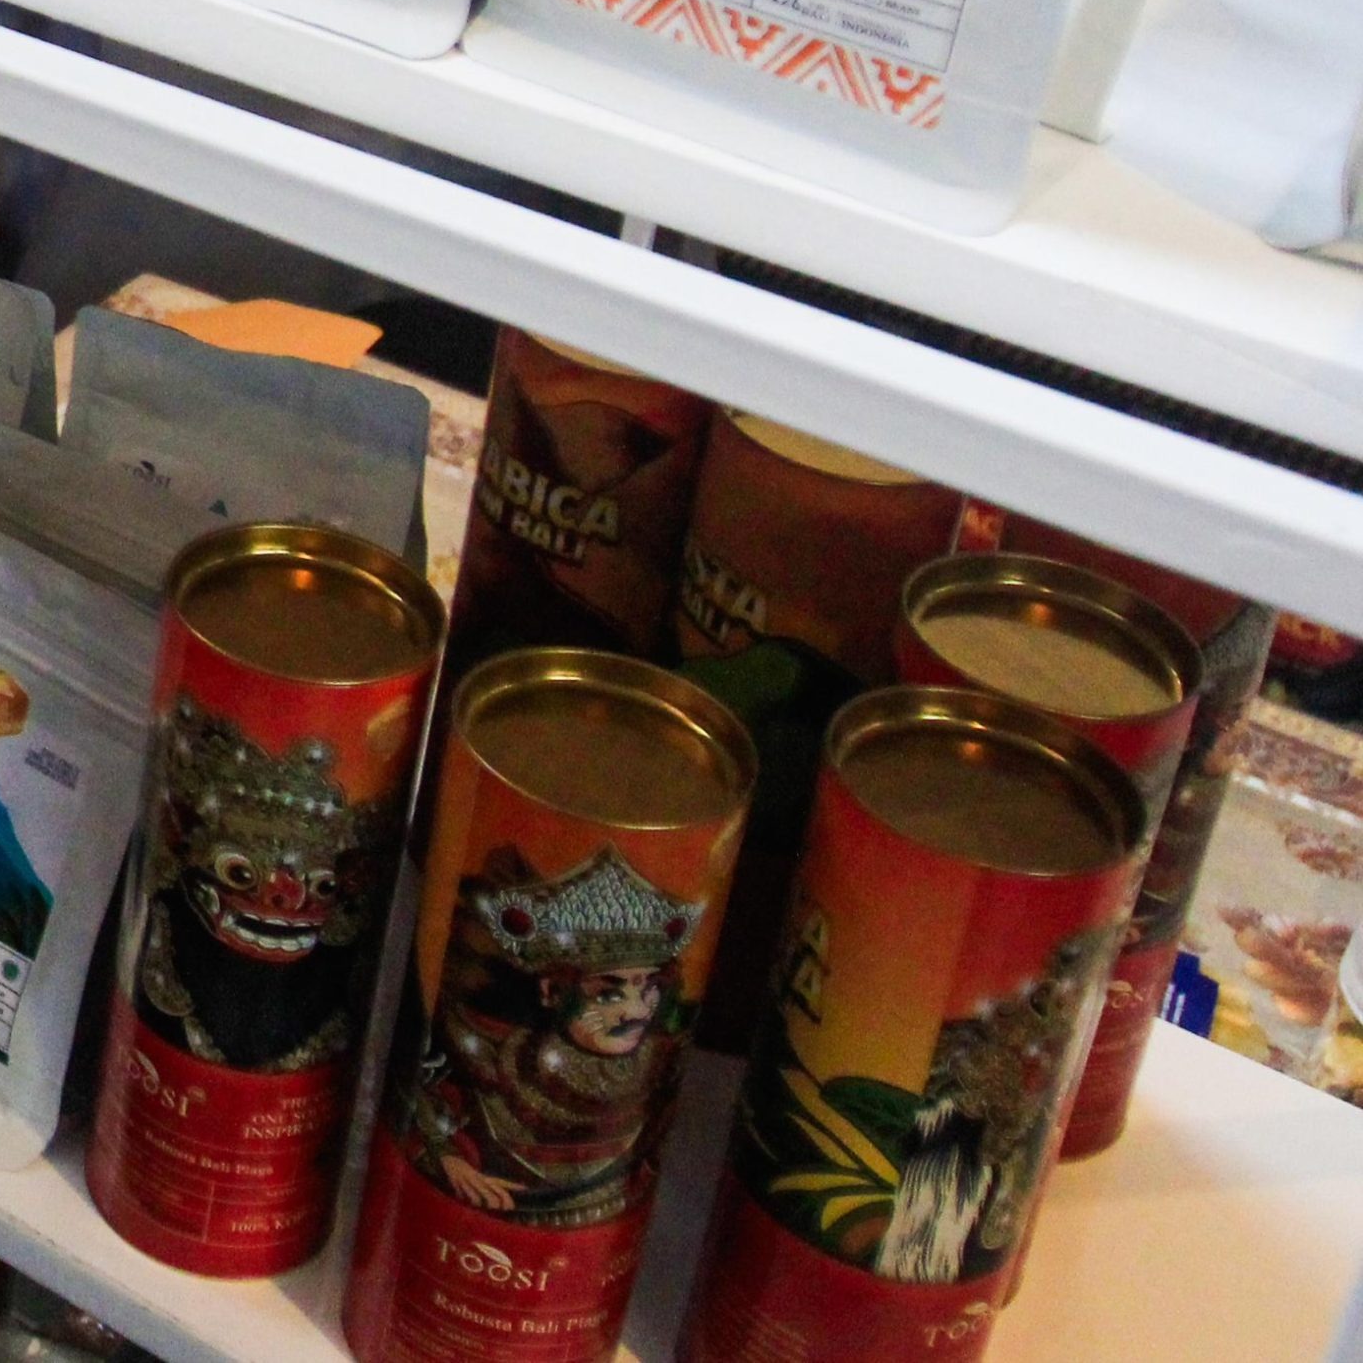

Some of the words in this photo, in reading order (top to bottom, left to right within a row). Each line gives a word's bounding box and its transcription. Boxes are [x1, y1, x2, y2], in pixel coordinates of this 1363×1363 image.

[484, 442, 620, 539] ABICA
[511, 512, 586, 560] BALI
[128, 1053, 189, 1118] OOSI
[437, 1237, 549, 1291] TOOSI
[434, 1292, 512, 1332] Robusta
[521, 1319, 558, 1335] Bali
